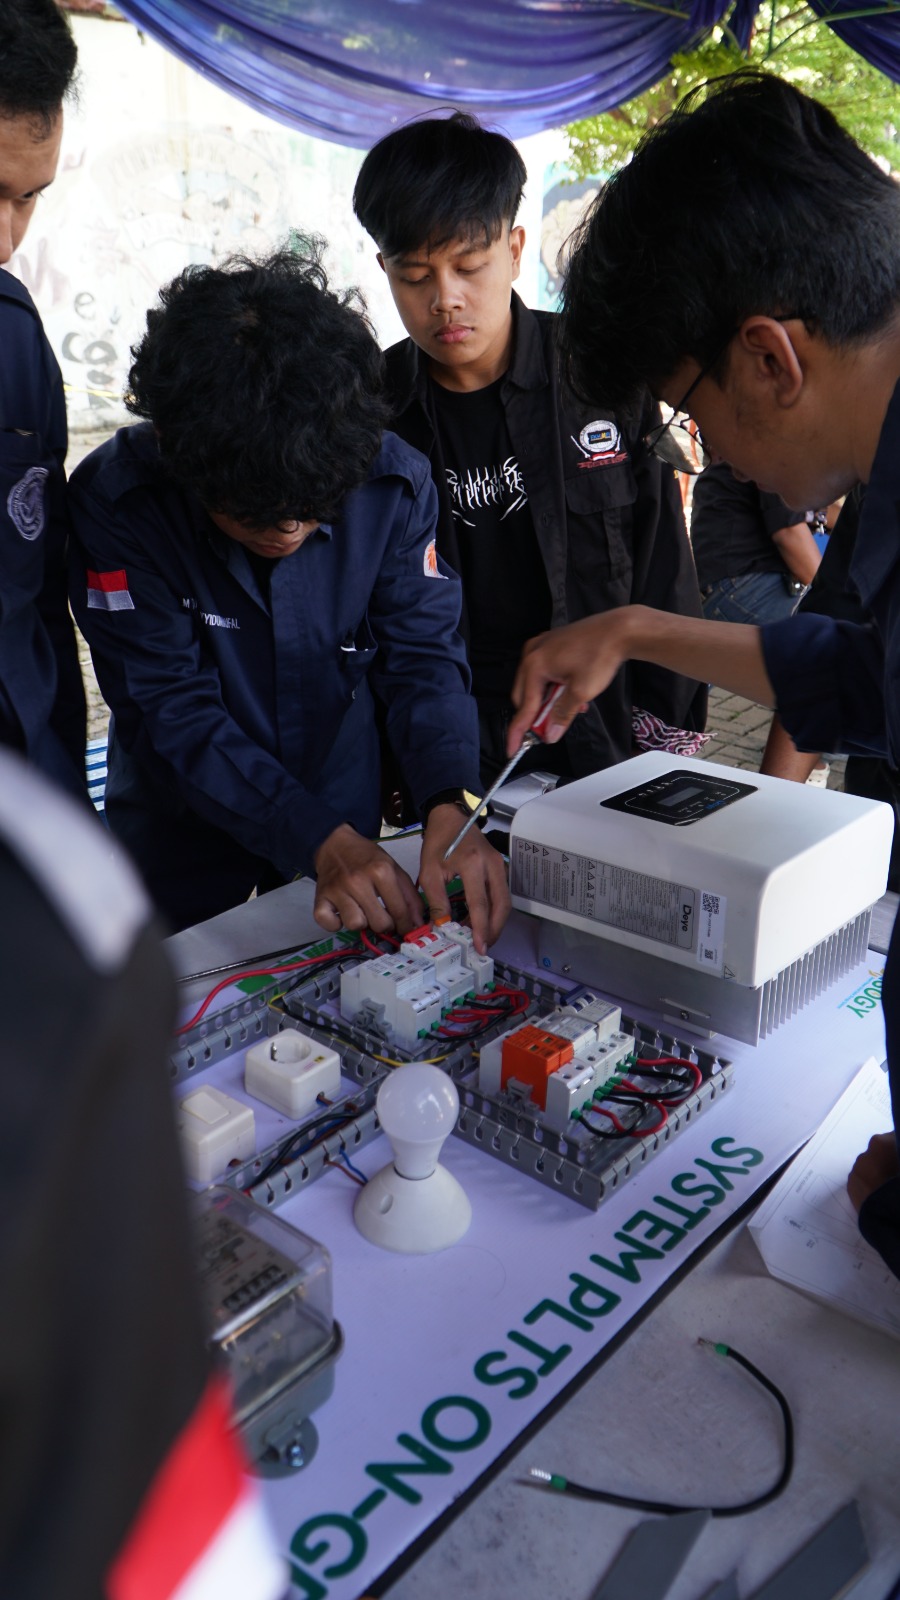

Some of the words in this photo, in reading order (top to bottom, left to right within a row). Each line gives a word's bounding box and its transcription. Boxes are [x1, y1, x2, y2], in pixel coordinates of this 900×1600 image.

[681, 904, 692, 932] Deye
[589, 1137, 764, 1283] SYSTEM
[473, 1272, 621, 1400] PLTS
